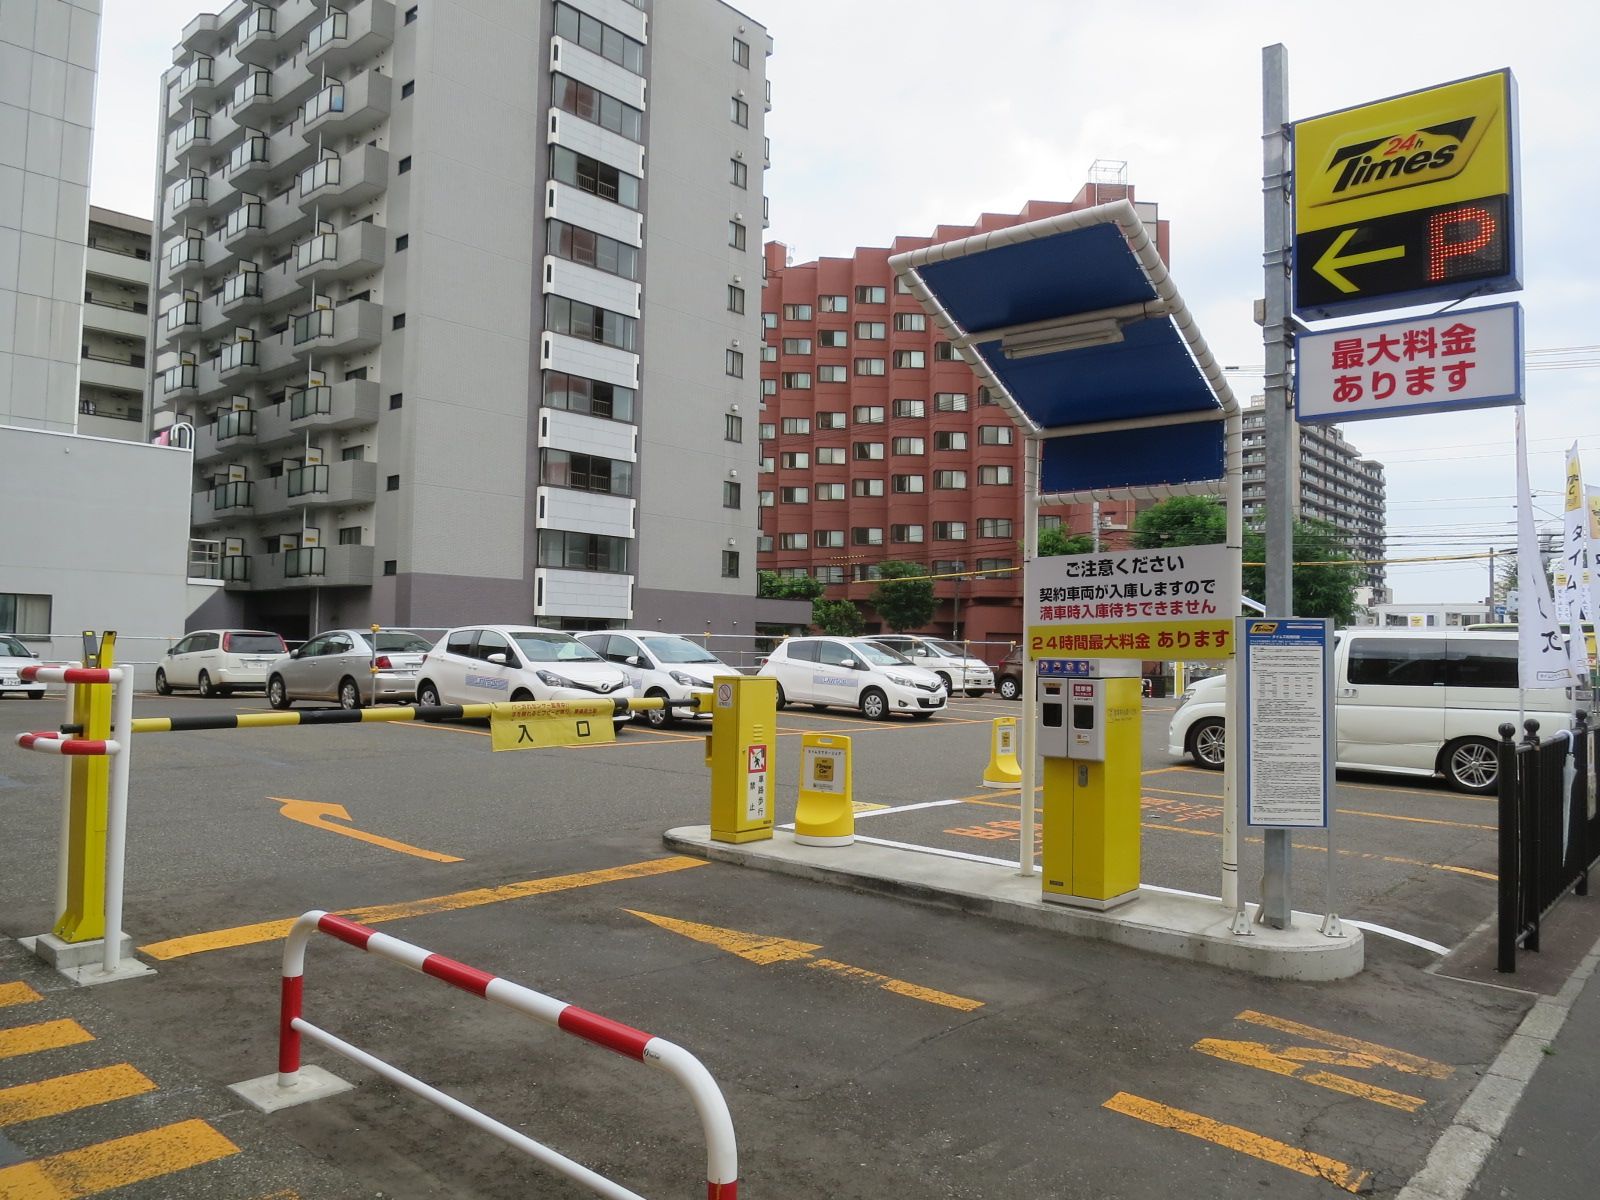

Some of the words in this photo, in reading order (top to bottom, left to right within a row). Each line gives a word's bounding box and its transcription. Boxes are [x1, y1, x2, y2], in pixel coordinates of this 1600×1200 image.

[1382, 131, 1424, 157] 24h
[1332, 144, 1459, 193] Times
[1429, 207, 1496, 281] P
[1331, 322, 1477, 370] 最大料金
[1332, 360, 1476, 404] あります
[1065, 554, 1185, 578] ご注意ください
[1039, 579, 1216, 602] 契約車両が入庫しますので
[1039, 599, 1217, 621] 満車時入庫待ちできません
[1157, 629, 1230, 648] あります
